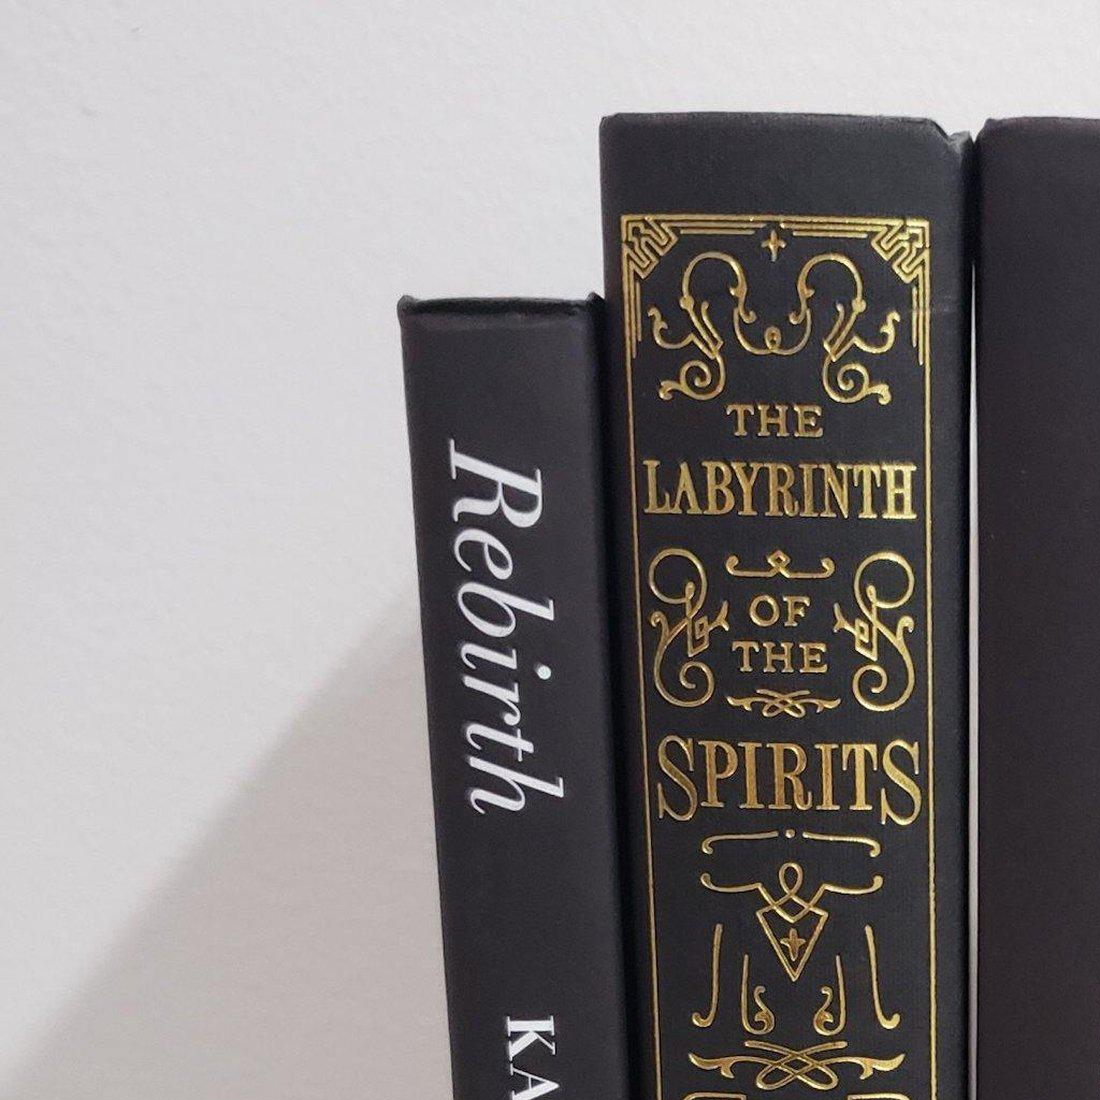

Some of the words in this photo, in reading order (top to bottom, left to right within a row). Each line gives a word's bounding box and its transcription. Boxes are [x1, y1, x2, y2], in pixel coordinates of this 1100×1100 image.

[727, 404, 823, 437] THE
[643, 460, 917, 519] LABYRINTH
[449, 439, 564, 814] Rebirth
[749, 595, 810, 626] OF
[732, 641, 827, 673] THE
[658, 737, 922, 827] SPIRITS
